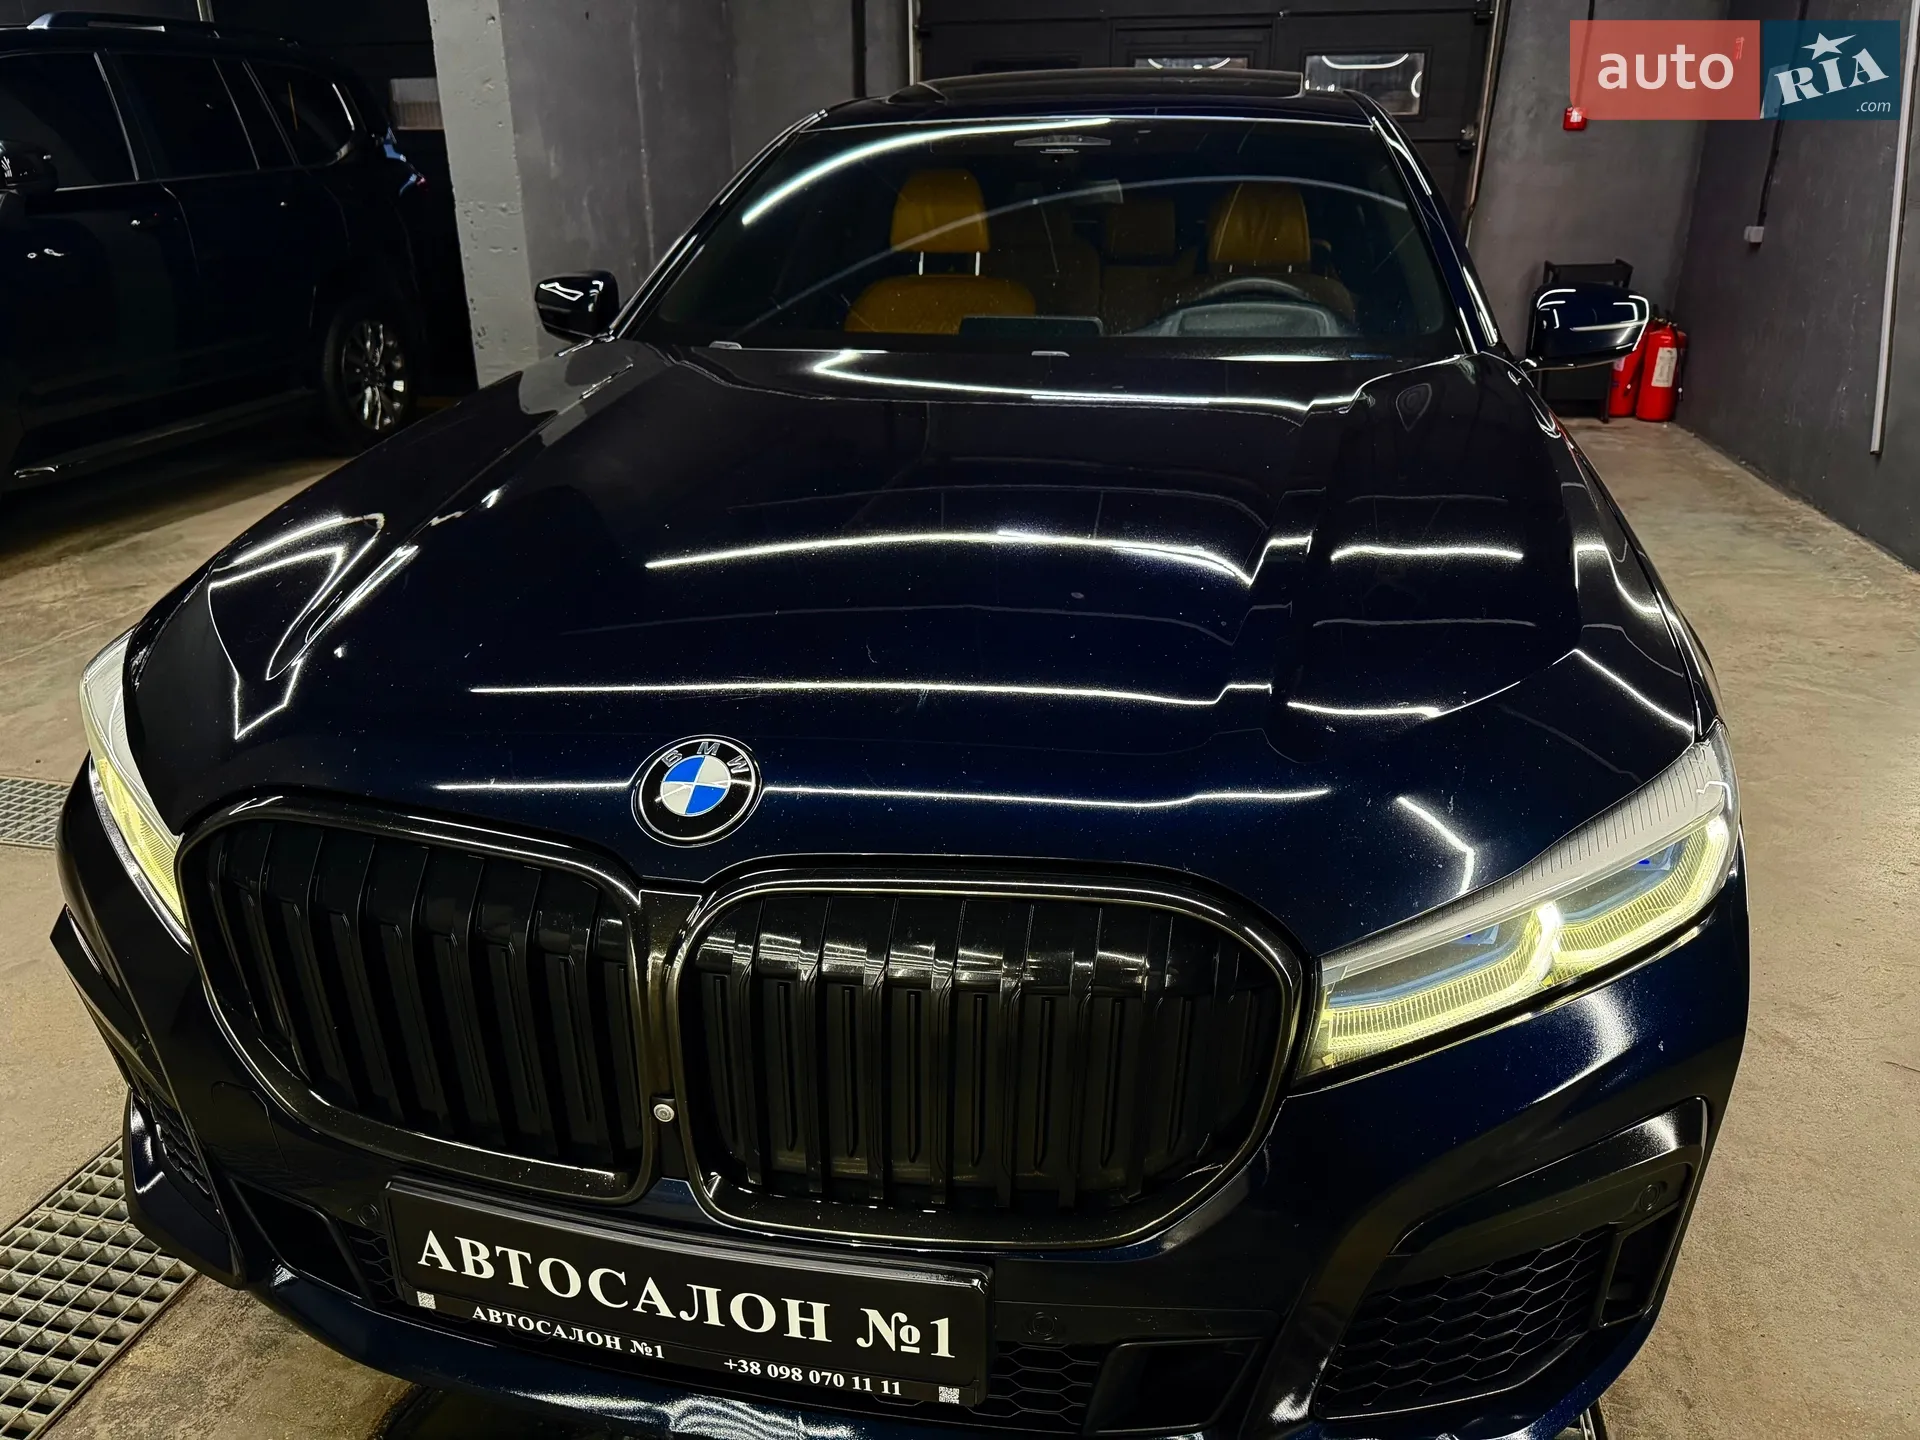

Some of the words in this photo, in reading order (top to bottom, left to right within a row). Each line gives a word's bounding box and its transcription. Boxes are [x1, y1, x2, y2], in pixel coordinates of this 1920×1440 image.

[660, 741, 750, 774] BMW
[417, 1229, 833, 1343] АВТОСАЛОН
[856, 1307, 956, 1359] №1
[472, 1306, 623, 1351] АВТОСАЛОН
[629, 1339, 665, 1359] №1
[723, 1358, 762, 1376] +38
[766, 1363, 803, 1382] 098
[808, 1369, 845, 1388] 070
[851, 1376, 873, 1392] 11
[880, 1380, 902, 1396] 11
